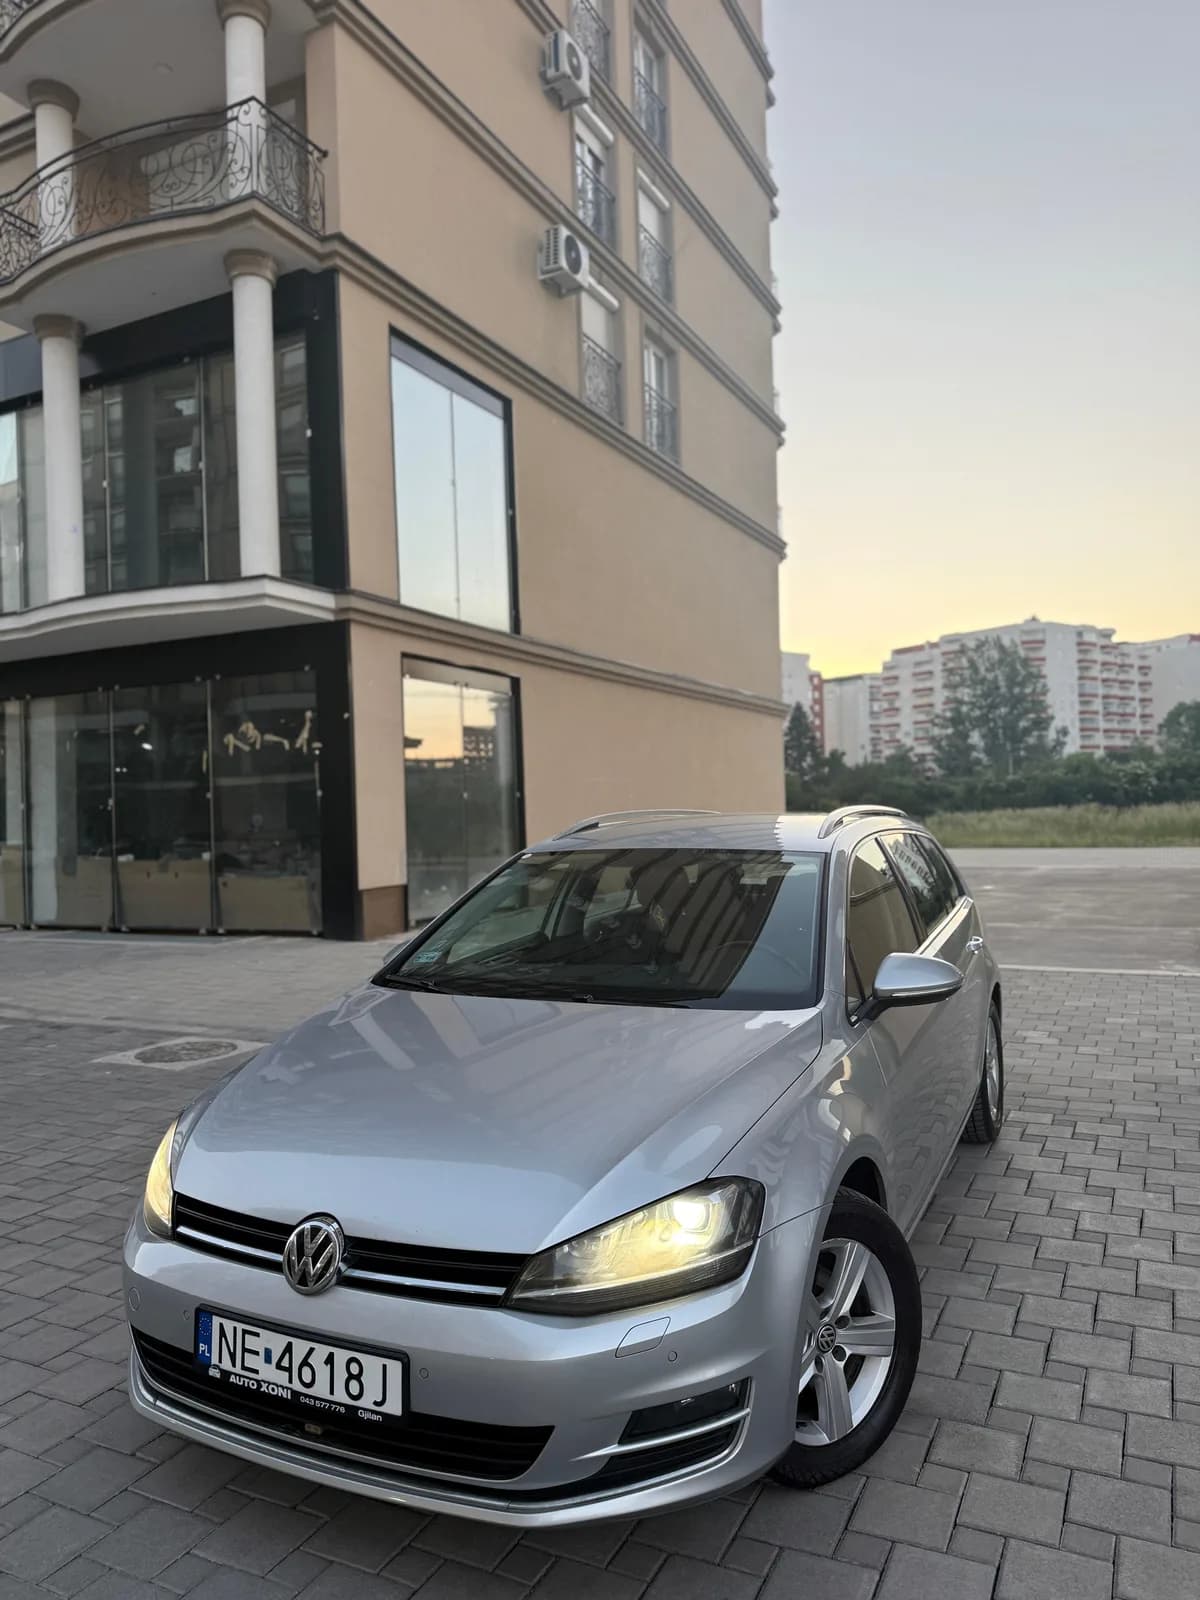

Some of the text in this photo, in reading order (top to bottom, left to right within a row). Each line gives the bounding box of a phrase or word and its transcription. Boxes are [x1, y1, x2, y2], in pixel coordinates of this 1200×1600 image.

[284, 1221, 339, 1293] VW
[200, 1343, 210, 1357] PL
[218, 1321, 387, 1407] NE 4618J
[230, 1374, 257, 1389] AUTO
[260, 1381, 291, 1400] XONI
[300, 1396, 314, 1406] 043
[357, 1409, 383, 1422] Gjilan
